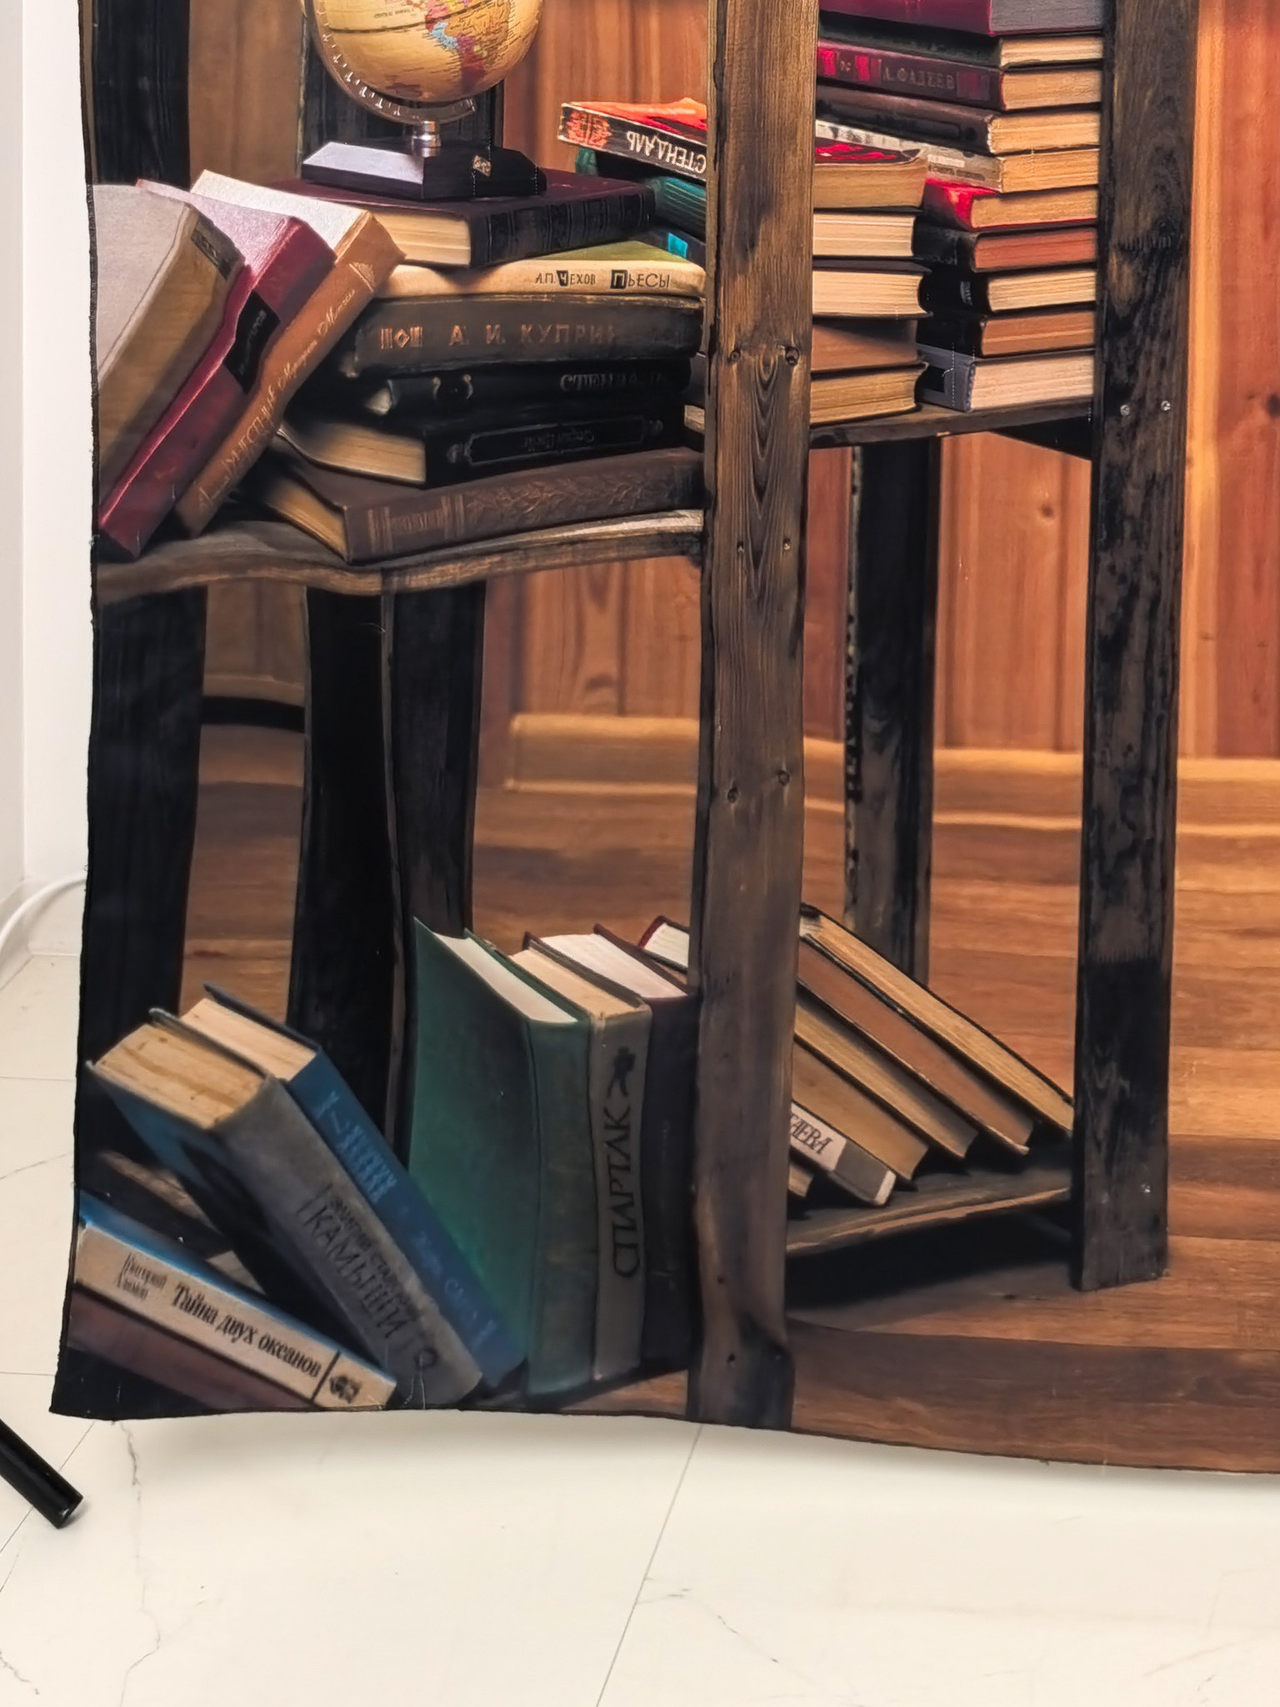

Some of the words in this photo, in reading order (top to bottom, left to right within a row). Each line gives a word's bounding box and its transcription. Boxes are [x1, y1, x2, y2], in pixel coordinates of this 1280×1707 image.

[627, 130, 707, 175] СТЕНДАЛЬ
[171, 1283, 220, 1326] Тайна
[215, 1313, 259, 1346] двух
[257, 1335, 323, 1379] океанов
